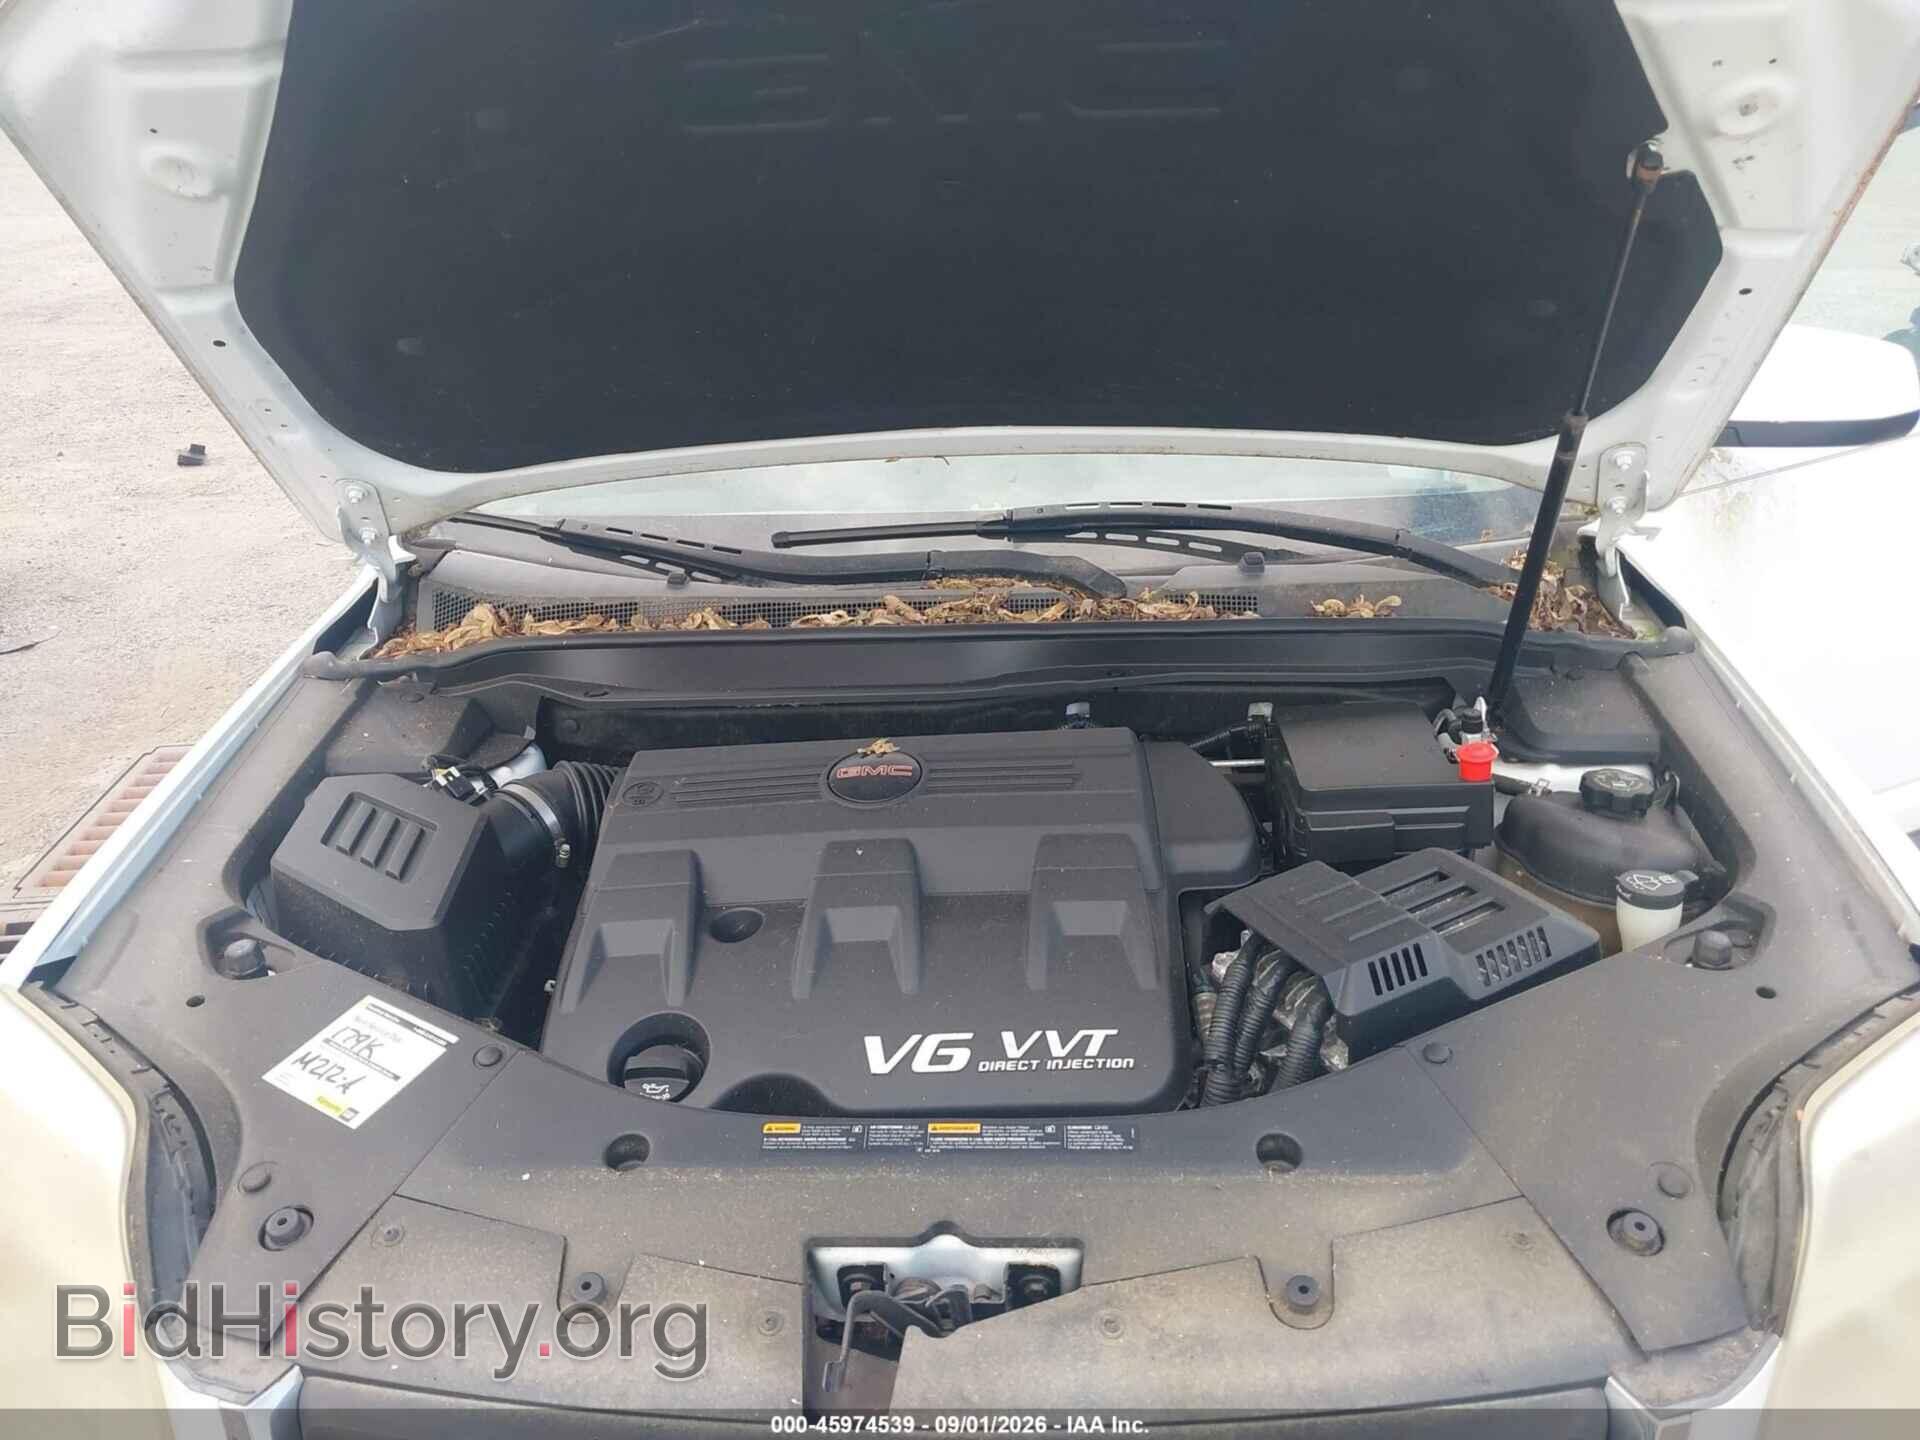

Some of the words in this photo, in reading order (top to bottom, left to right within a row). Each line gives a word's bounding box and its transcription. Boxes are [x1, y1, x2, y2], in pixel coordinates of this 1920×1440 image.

[836, 764, 913, 779] GMC
[864, 1032, 975, 1074] V6
[1000, 1028, 1119, 1058] VVT
[978, 1059, 1040, 1072] DIRECT
[1046, 1058, 1134, 1070] INJECTION
